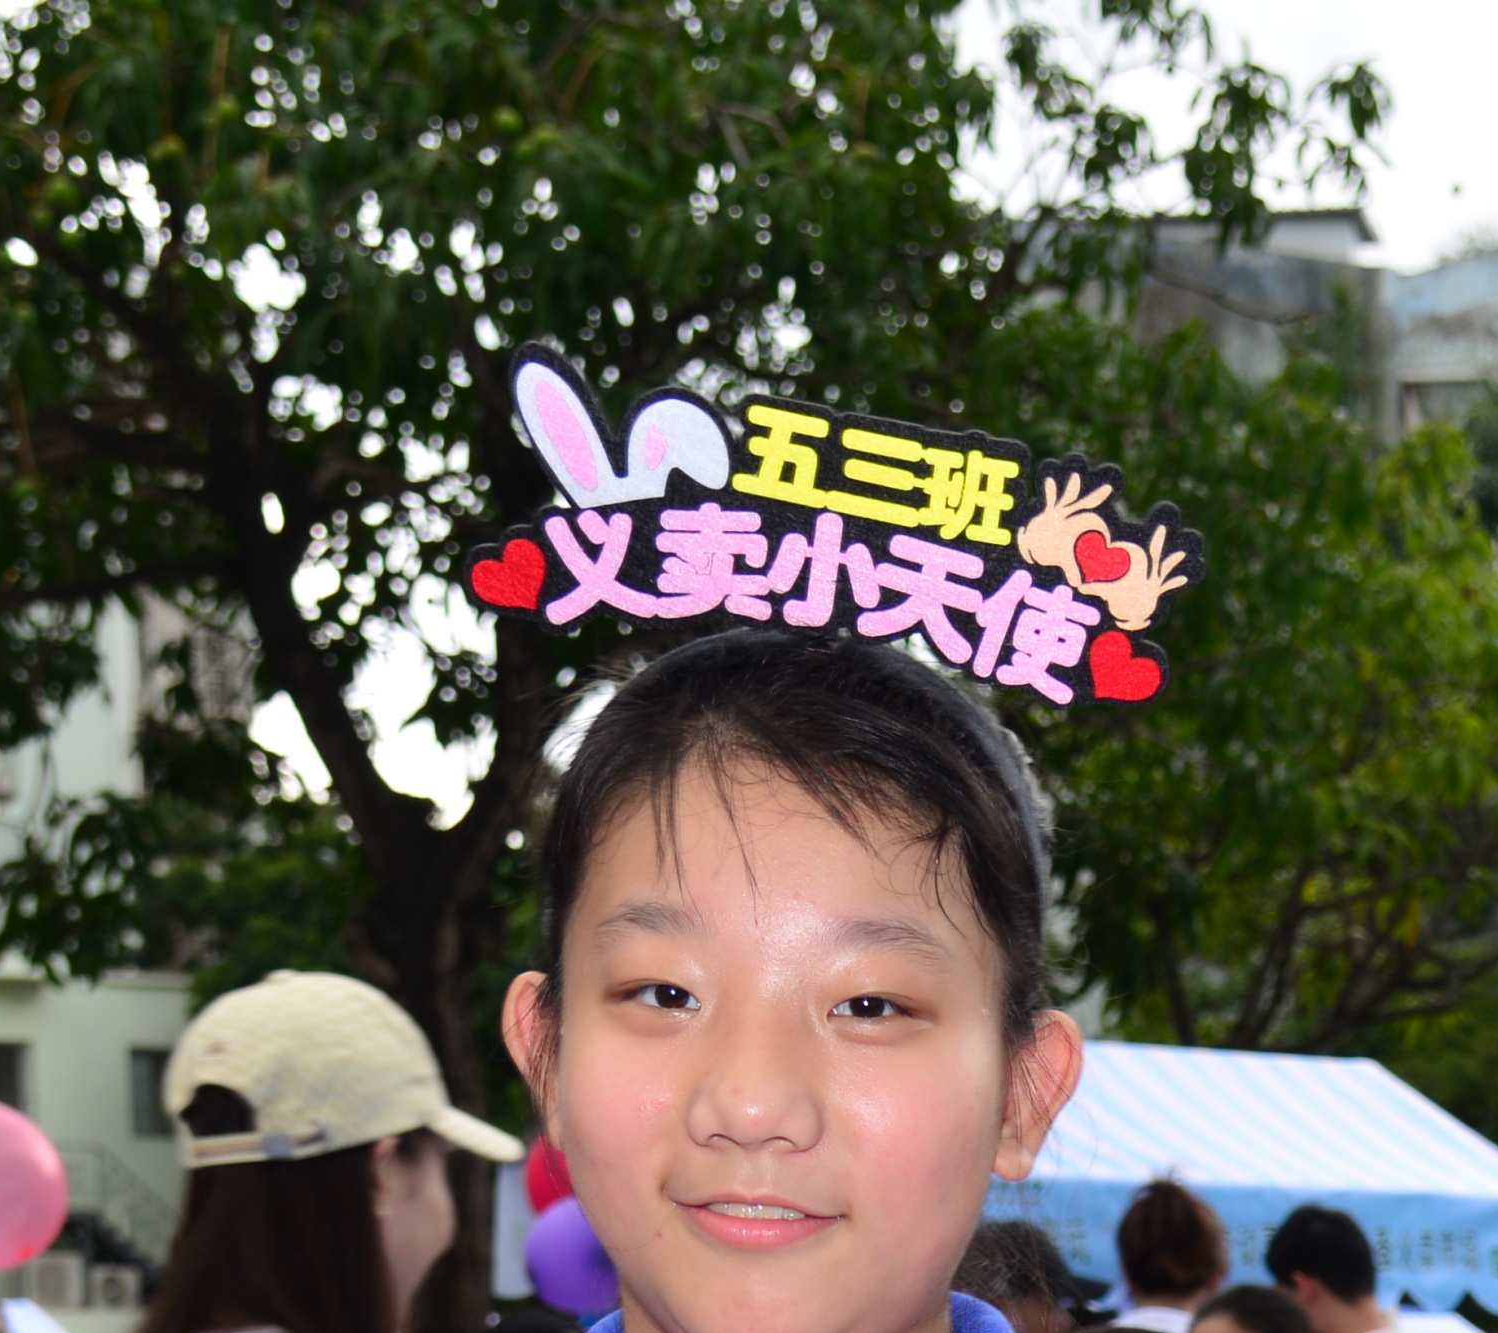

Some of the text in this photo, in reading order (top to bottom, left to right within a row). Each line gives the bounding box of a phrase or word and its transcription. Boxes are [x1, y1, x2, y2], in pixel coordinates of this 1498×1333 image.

[732, 403, 1022, 546] 五三班
[544, 501, 1101, 705] 义卖小天使
